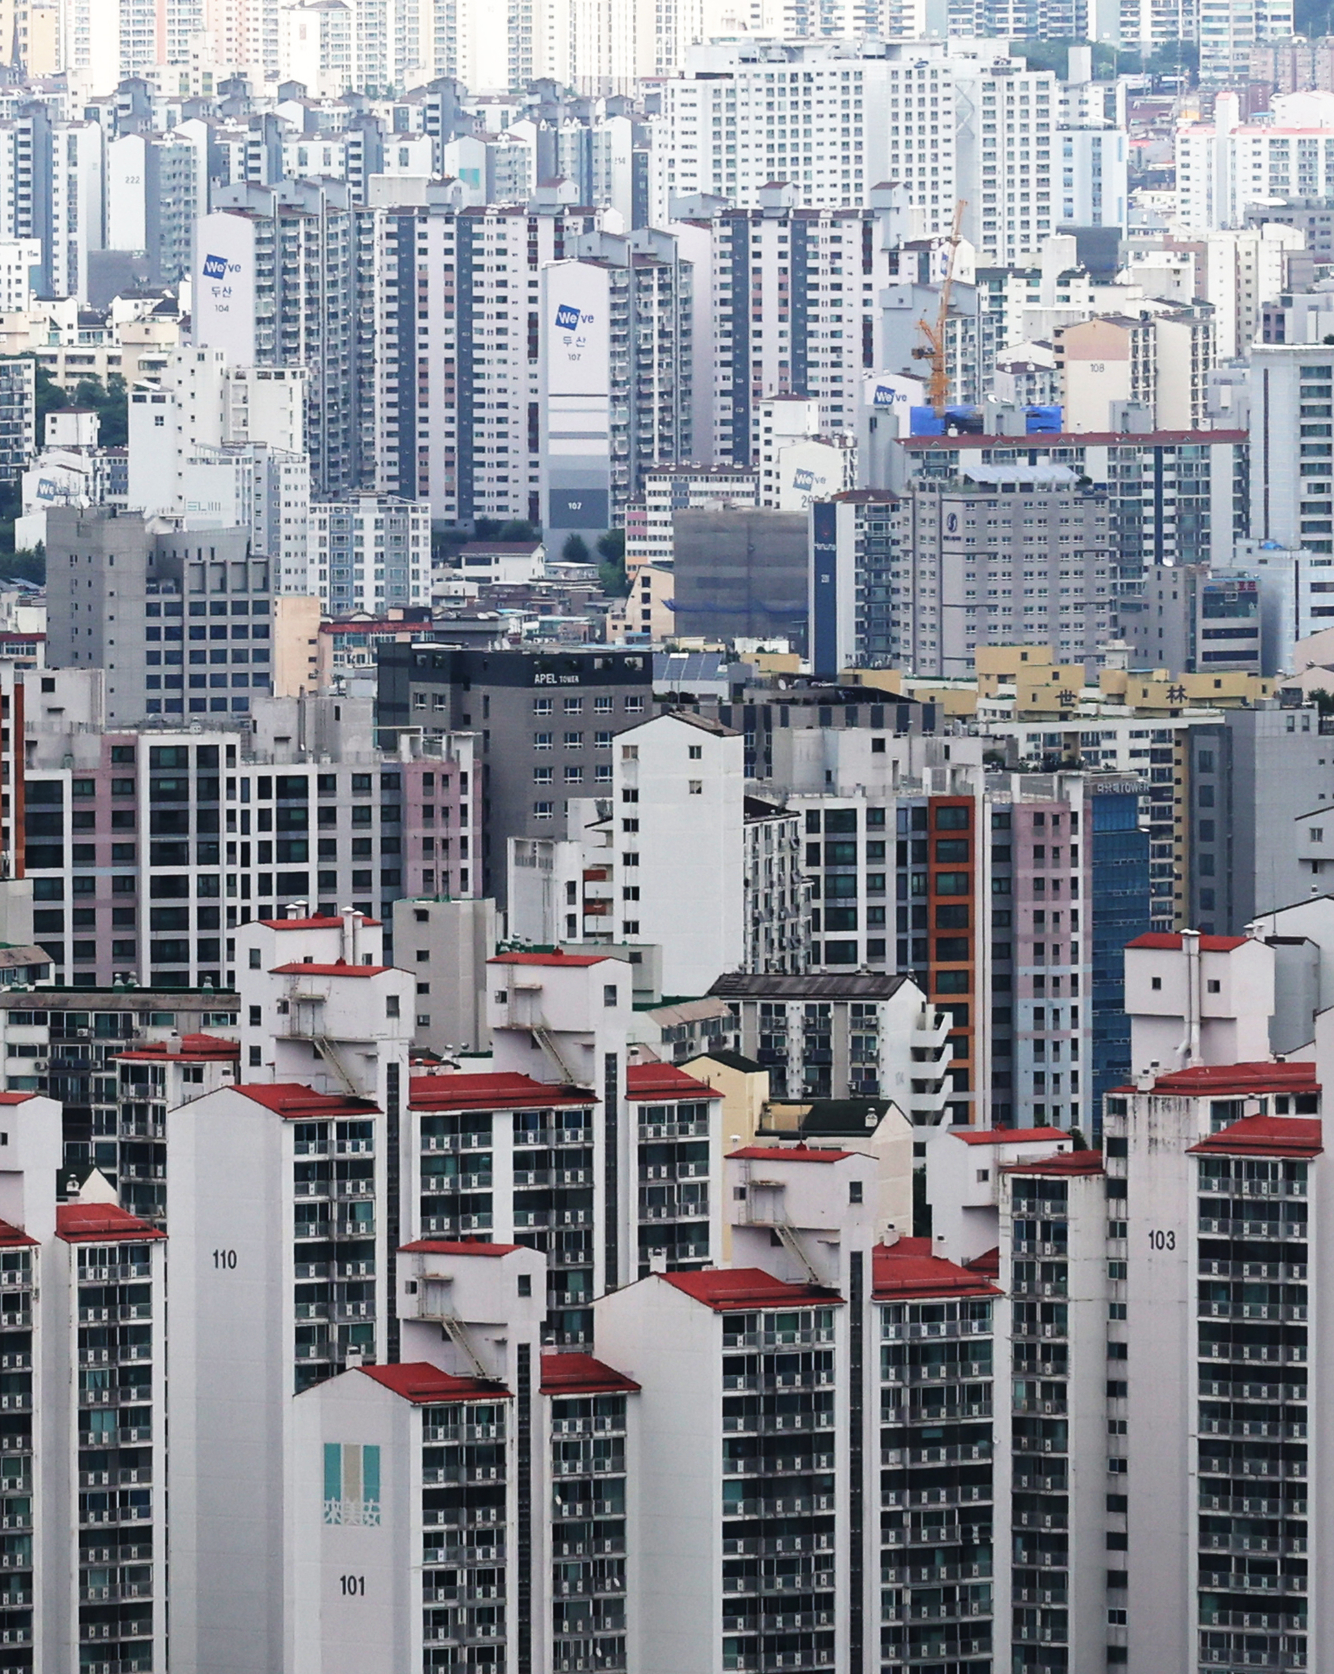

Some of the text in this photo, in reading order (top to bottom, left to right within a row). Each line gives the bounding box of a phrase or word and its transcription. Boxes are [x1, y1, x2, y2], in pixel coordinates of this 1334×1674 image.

[124, 176, 141, 185] 222
[211, 286, 233, 299] 두산
[214, 304, 230, 314] 104
[562, 335, 586, 350] 두산
[1089, 363, 1105, 373] 108
[568, 502, 582, 511] 107
[533, 673, 580, 685] APEL TOWER
[1164, 684, 1189, 705] 林
[1147, 1229, 1177, 1252] 103
[211, 1248, 239, 1270] 110
[339, 1574, 367, 1597] 101
